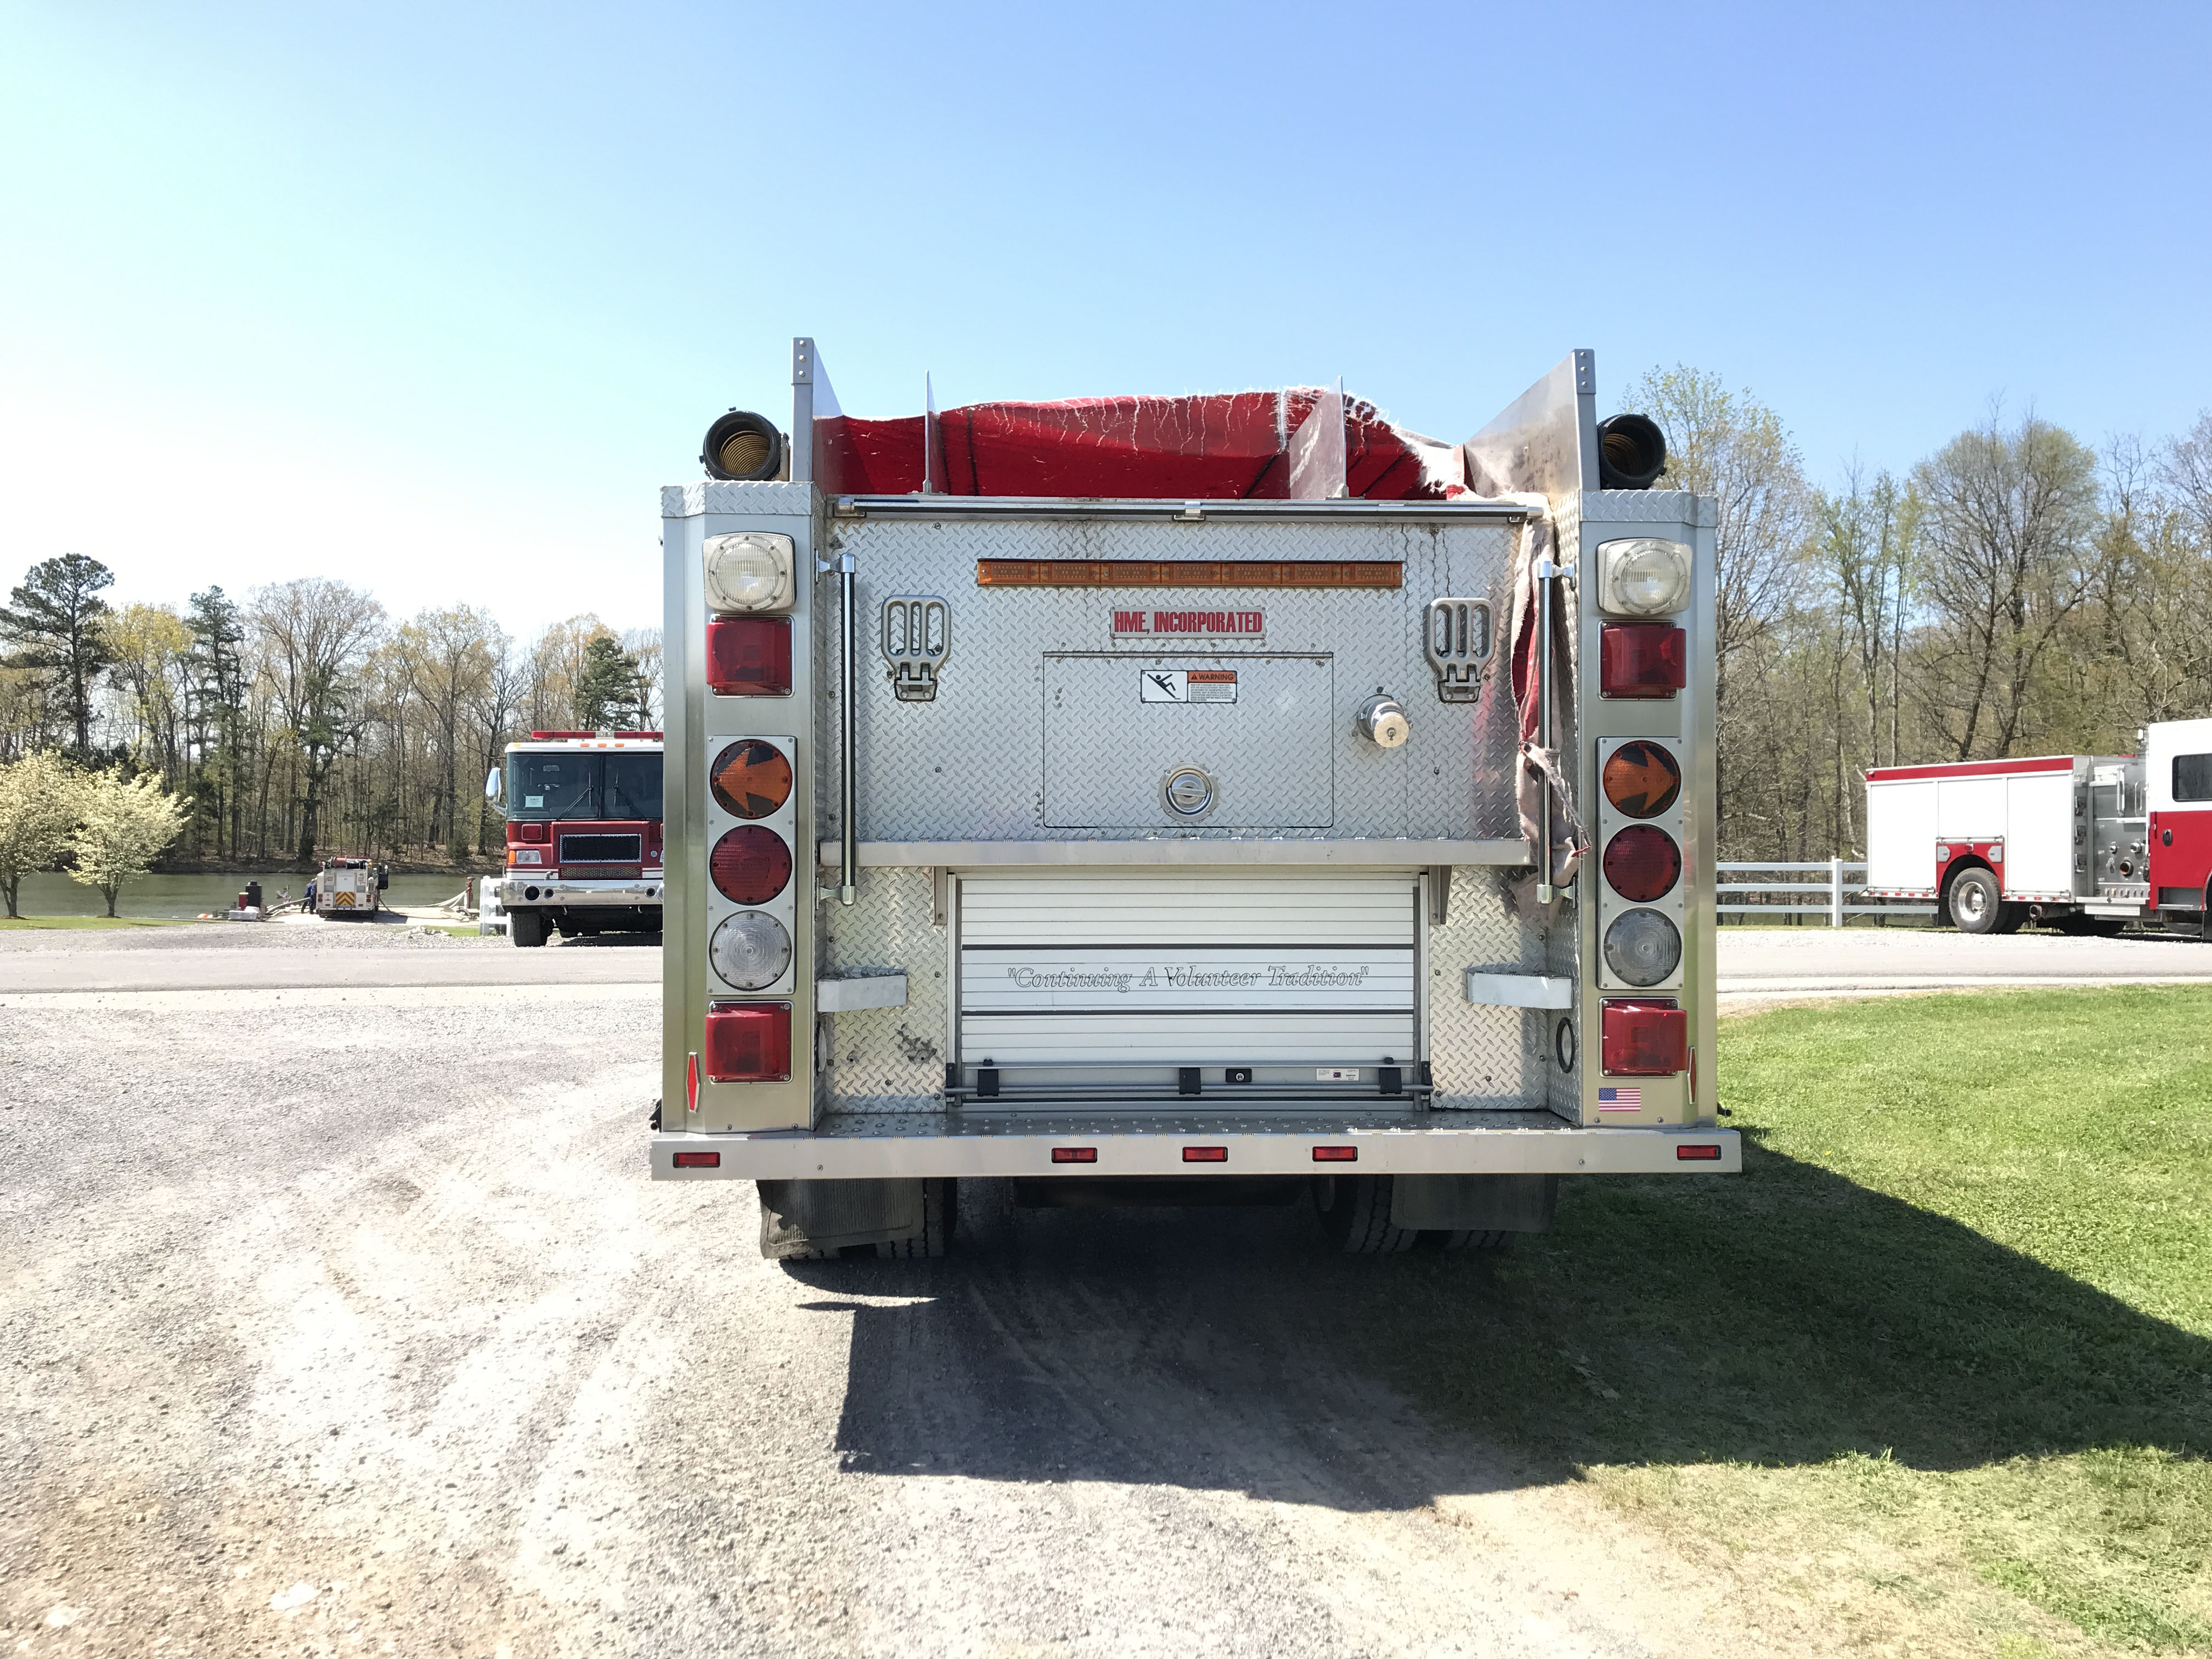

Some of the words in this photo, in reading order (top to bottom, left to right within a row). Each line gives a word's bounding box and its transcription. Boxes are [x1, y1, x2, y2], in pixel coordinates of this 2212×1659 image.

[1114, 611, 1150, 634] HME,
[1154, 612, 1262, 633] INCORPORATED
[1008, 967, 1132, 992] "Continuing
[1139, 967, 1158, 986] A
[1165, 965, 1261, 986] Volunteer
[1268, 964, 1369, 986] Tradition"
